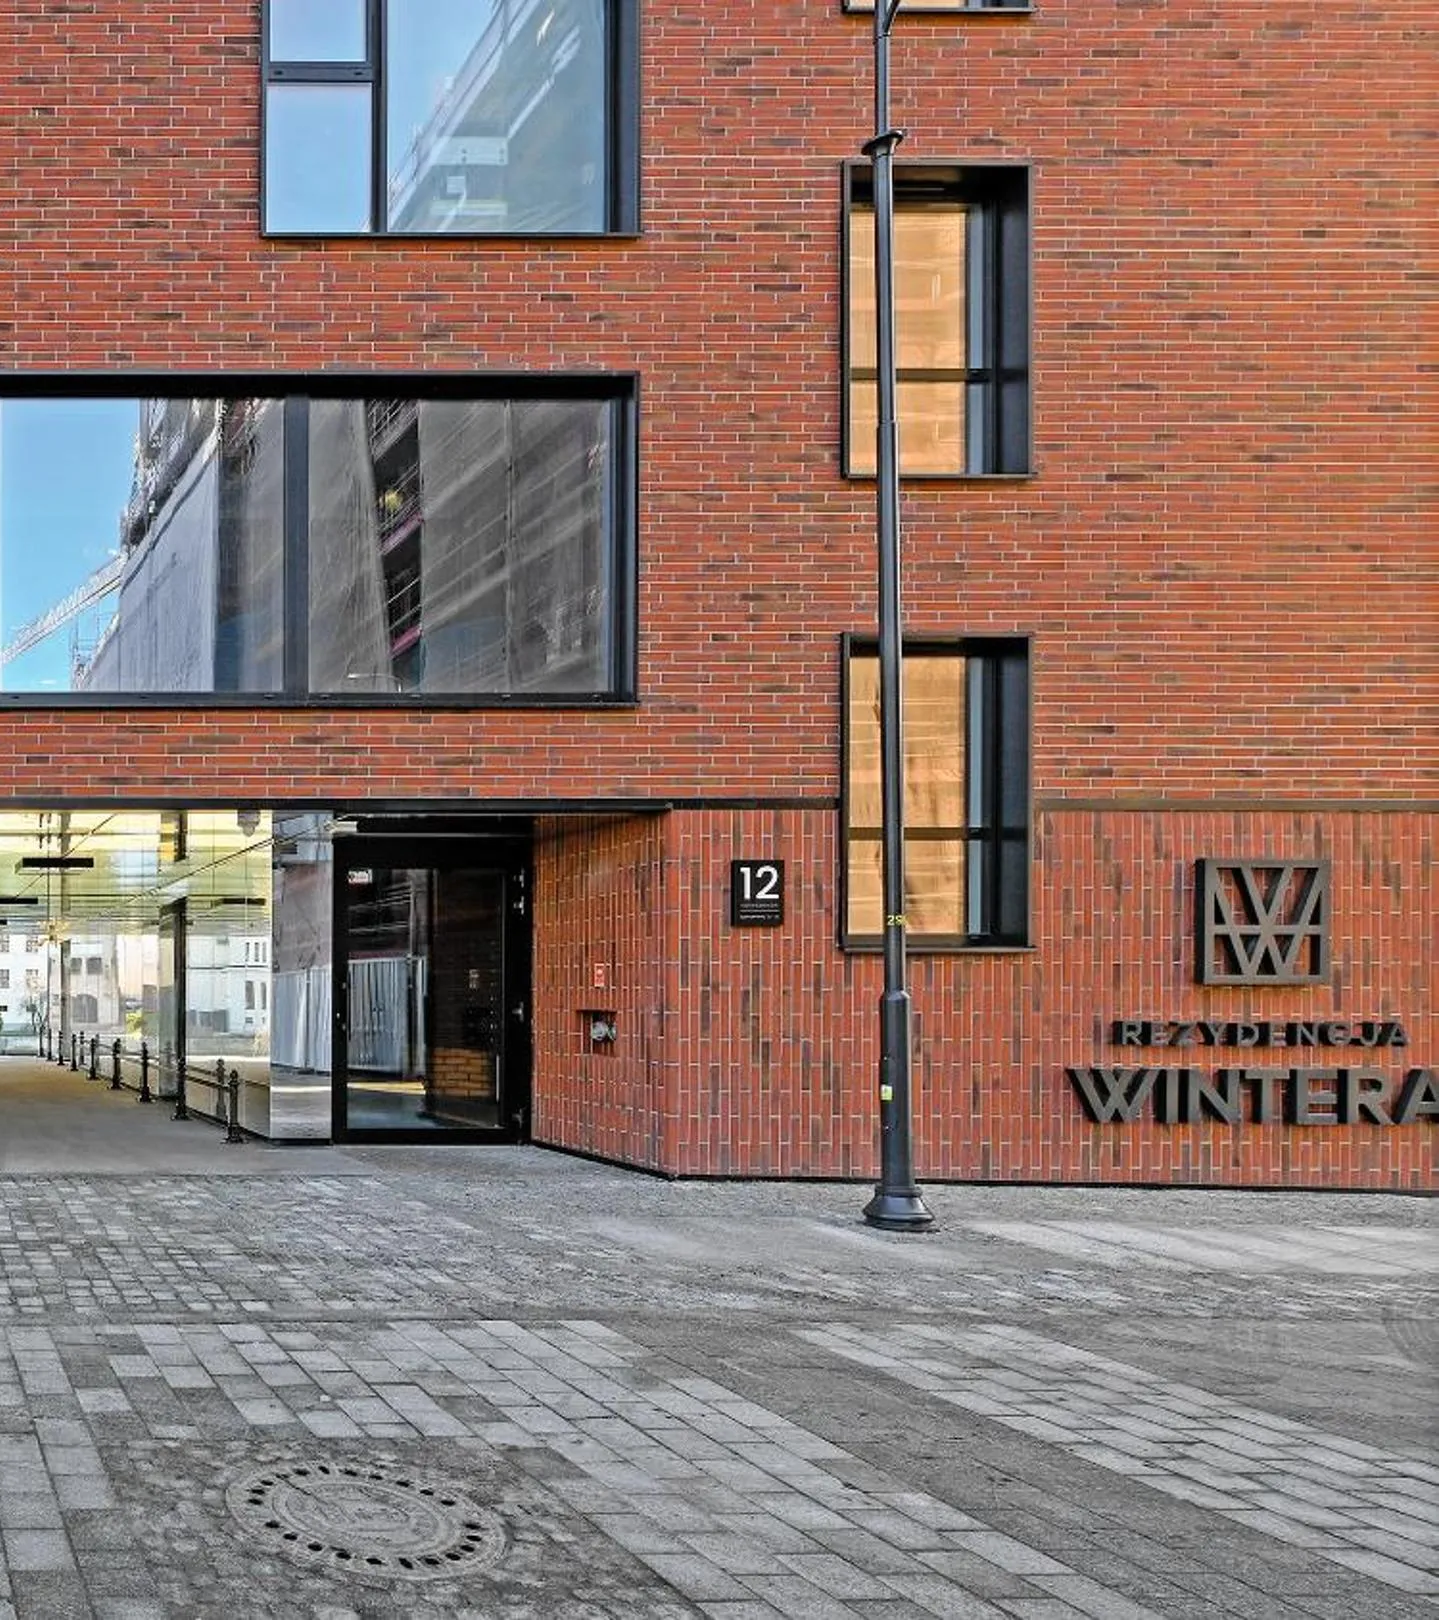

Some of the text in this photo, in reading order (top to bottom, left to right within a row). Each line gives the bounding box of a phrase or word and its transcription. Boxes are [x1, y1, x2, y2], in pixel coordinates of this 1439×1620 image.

[740, 866, 779, 900] 12
[1114, 1021, 1409, 1046] REZYDENCJA
[1067, 1069, 1439, 1125] WINTERA
